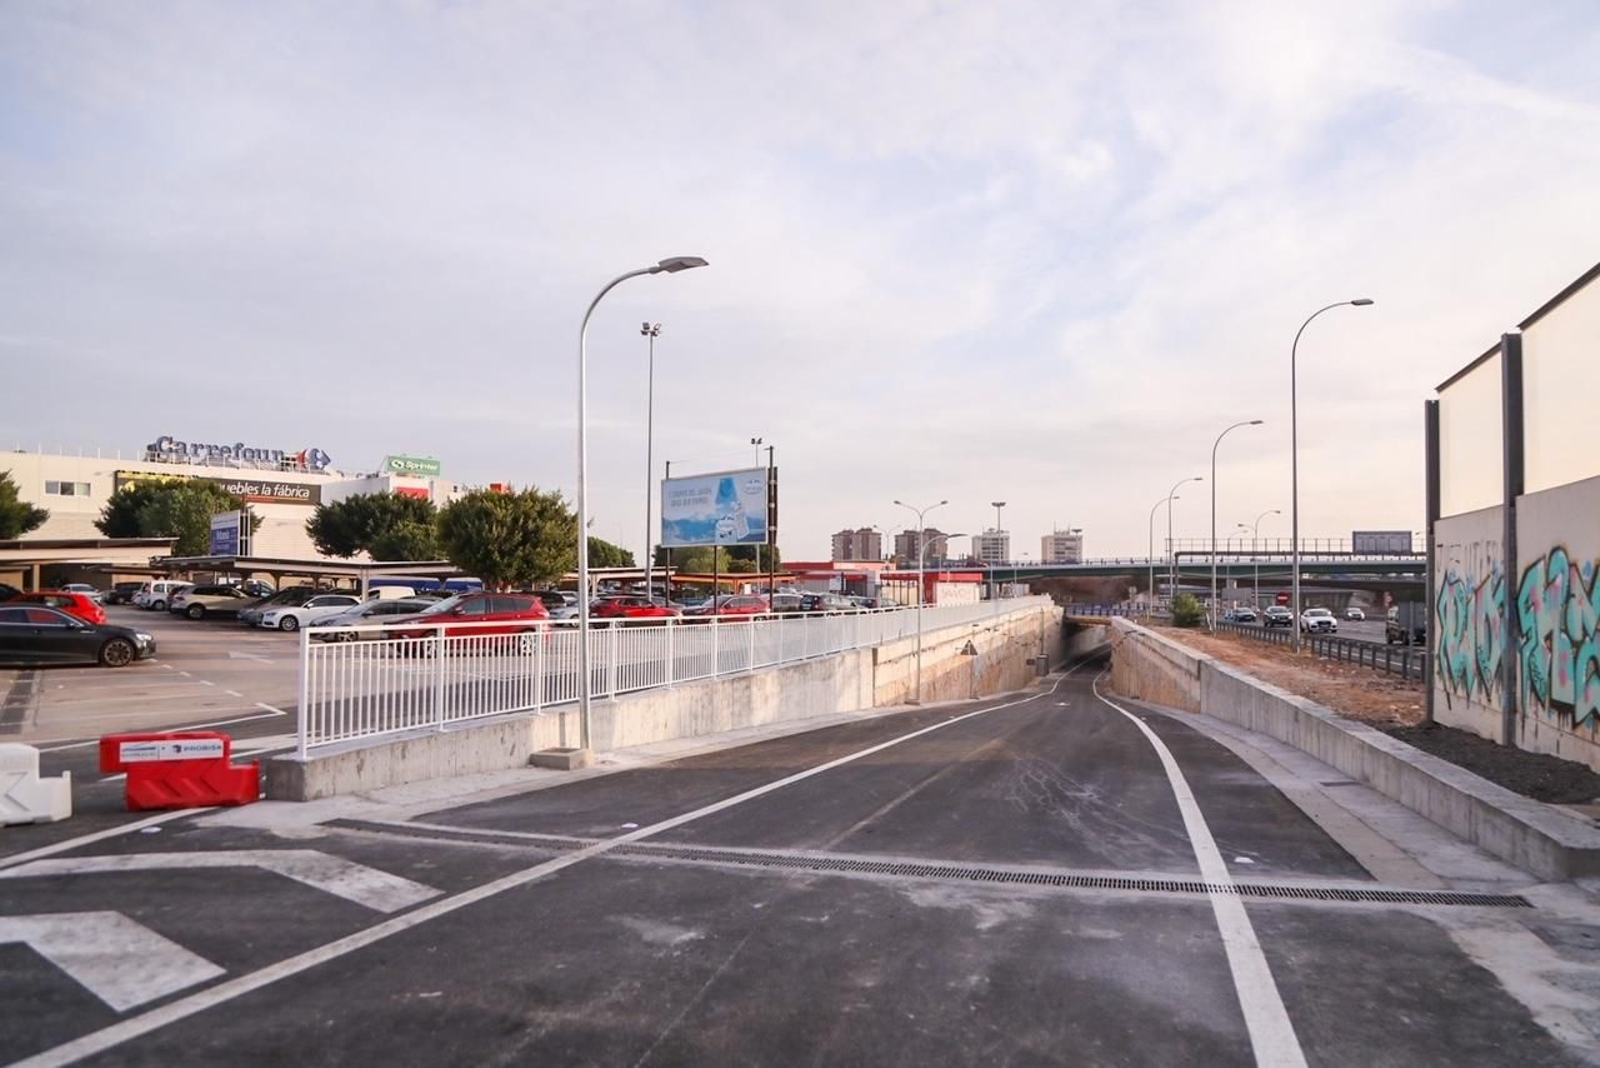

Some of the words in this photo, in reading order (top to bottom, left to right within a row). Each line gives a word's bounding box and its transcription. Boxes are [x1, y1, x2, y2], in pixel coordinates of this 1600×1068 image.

[155, 436, 285, 462] Carrefour
[219, 481, 258, 495] uebles
[261, 483, 271, 496] la
[273, 483, 311, 498] fábrica
